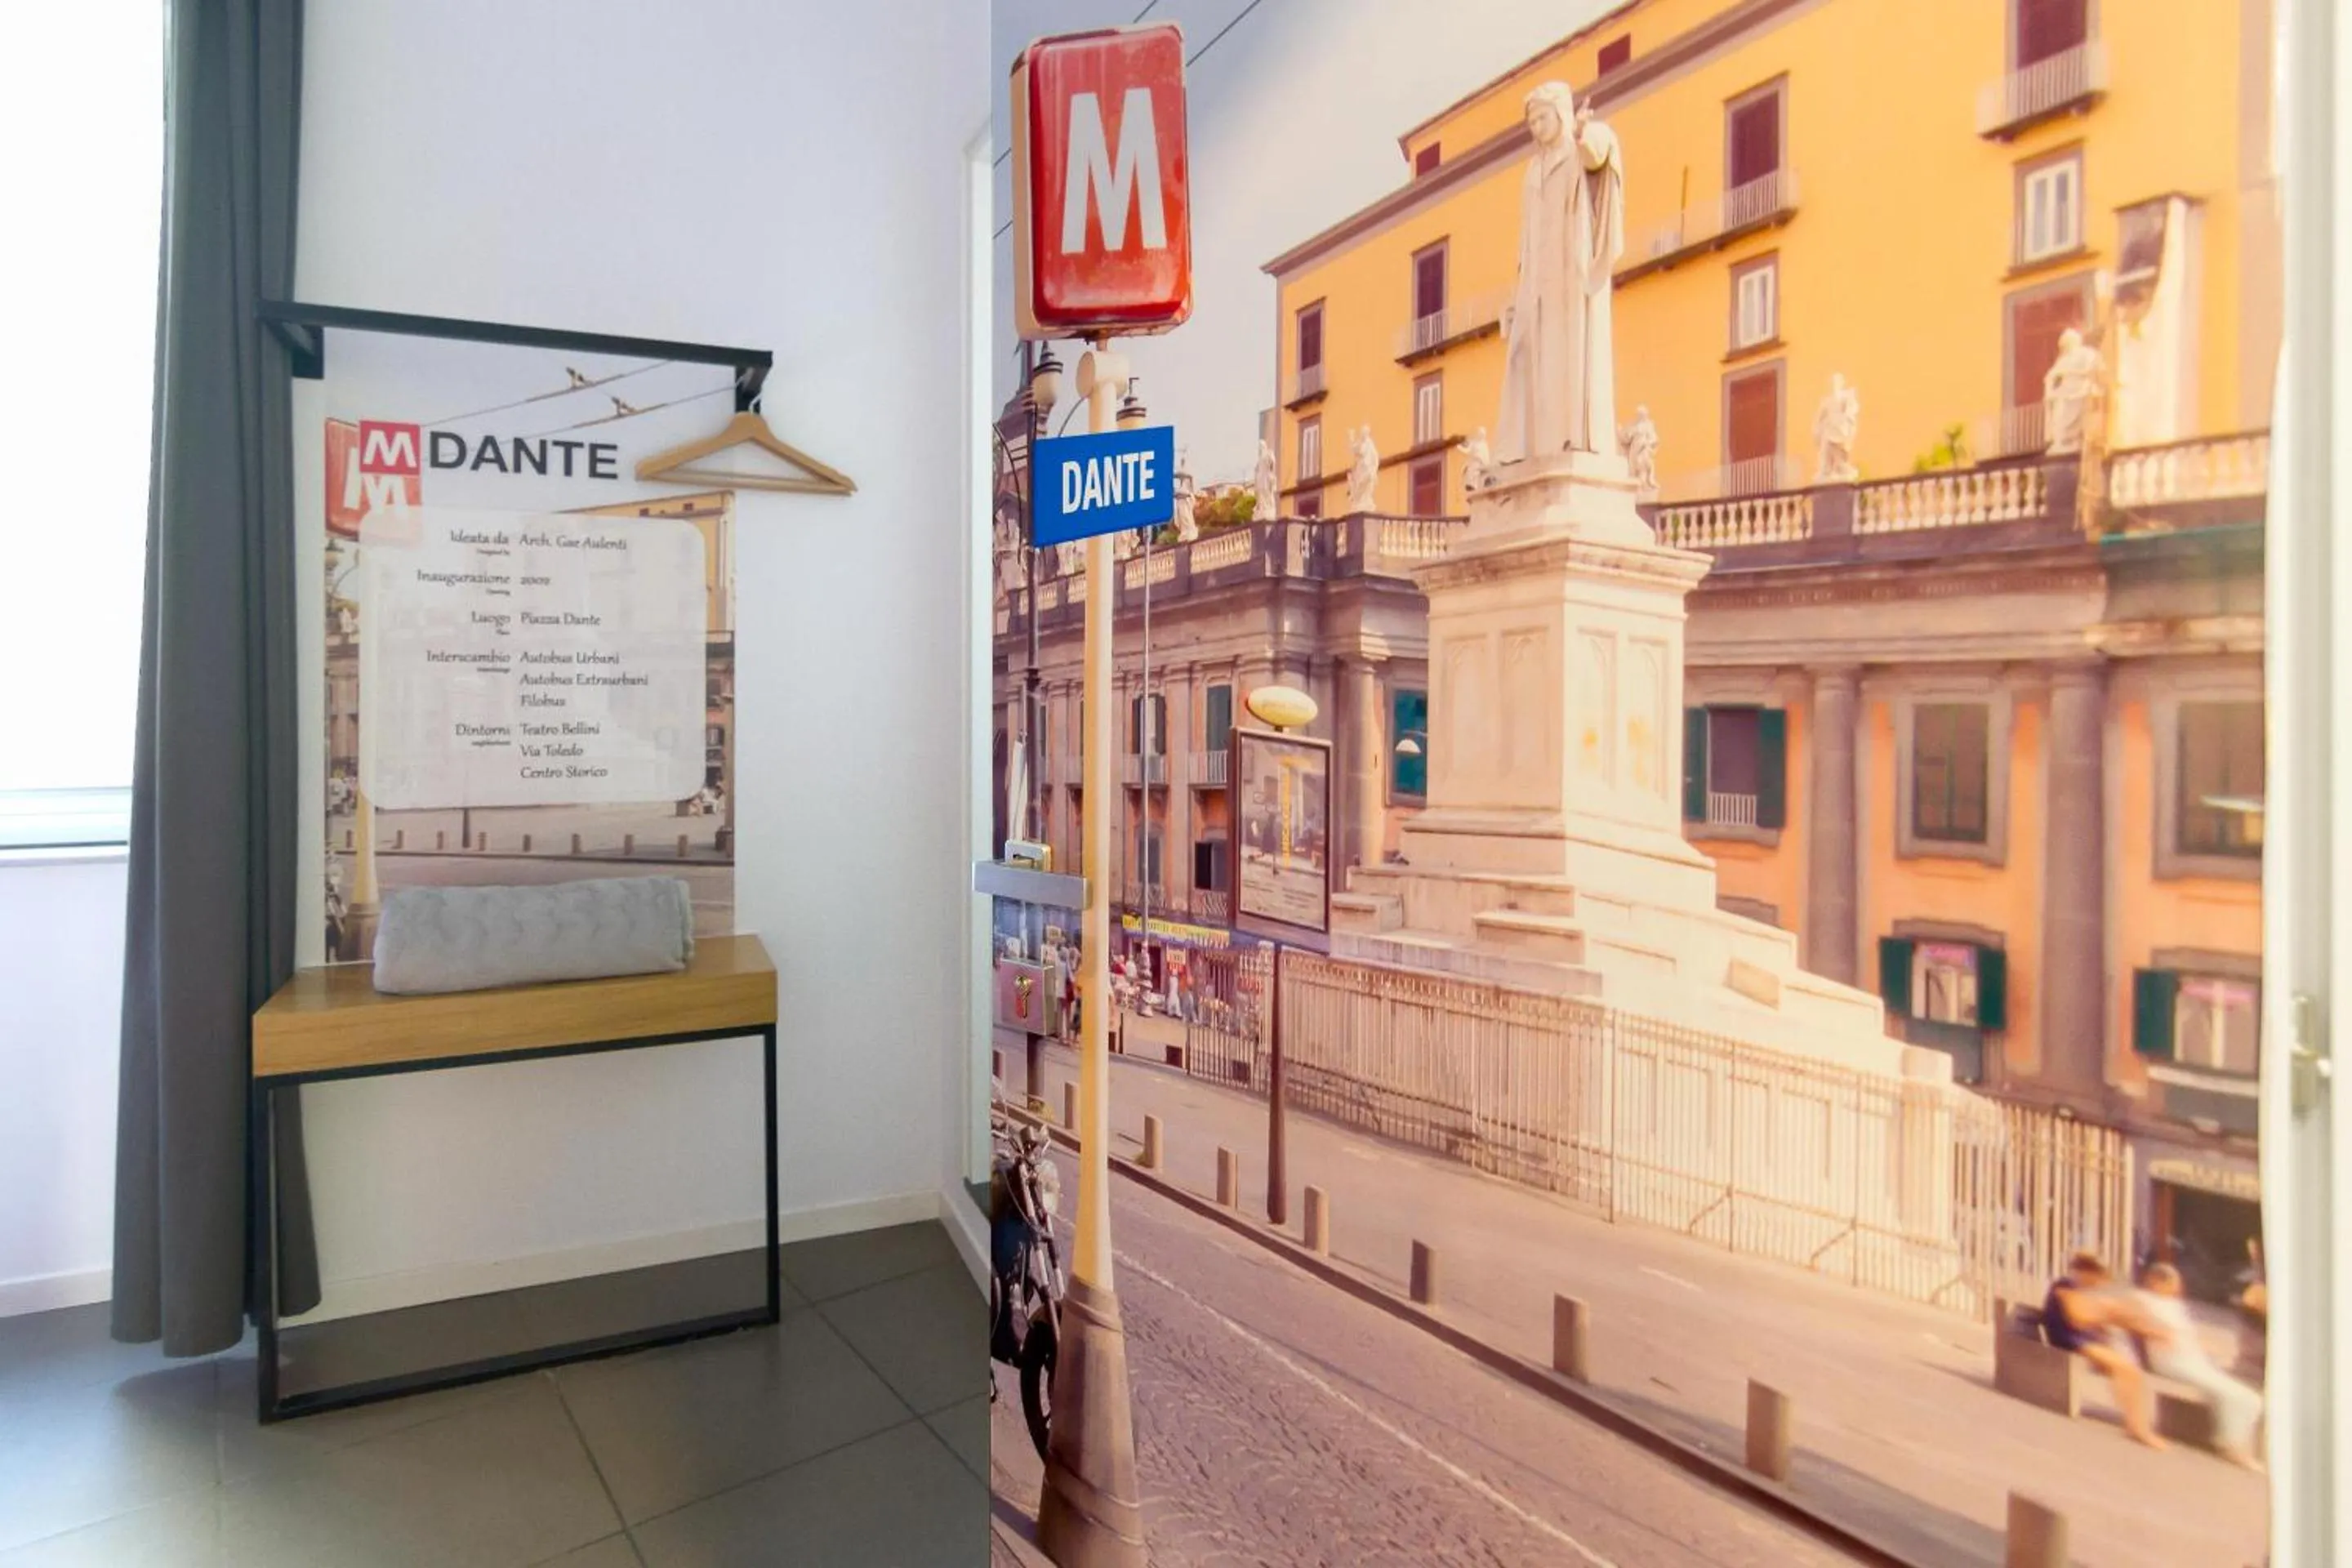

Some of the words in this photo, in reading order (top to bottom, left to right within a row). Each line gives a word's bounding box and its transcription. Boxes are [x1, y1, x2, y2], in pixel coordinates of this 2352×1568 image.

[1062, 87, 1168, 254] M
[430, 430, 618, 479] DANTE
[1062, 451, 1156, 514] DANTE
[450, 530, 490, 545] Ideata
[493, 532, 509, 545] da
[417, 569, 510, 586] Inaugurazione
[471, 612, 510, 627] Luogo
[520, 612, 559, 626] Piazza
[564, 612, 601, 626] Dante
[519, 651, 572, 665] Autobus
[576, 653, 620, 666] Urbani
[519, 673, 572, 686] Autobus
[576, 674, 648, 687] Extraurbani
[520, 694, 566, 707] Filobus
[455, 724, 510, 736] Dintorni
[519, 724, 559, 735] Teatro
[563, 721, 600, 735] Bellini
[520, 744, 540, 757] Via
[544, 744, 584, 757] Toledo
[520, 767, 564, 779] Centro
[566, 765, 608, 779] Storico
